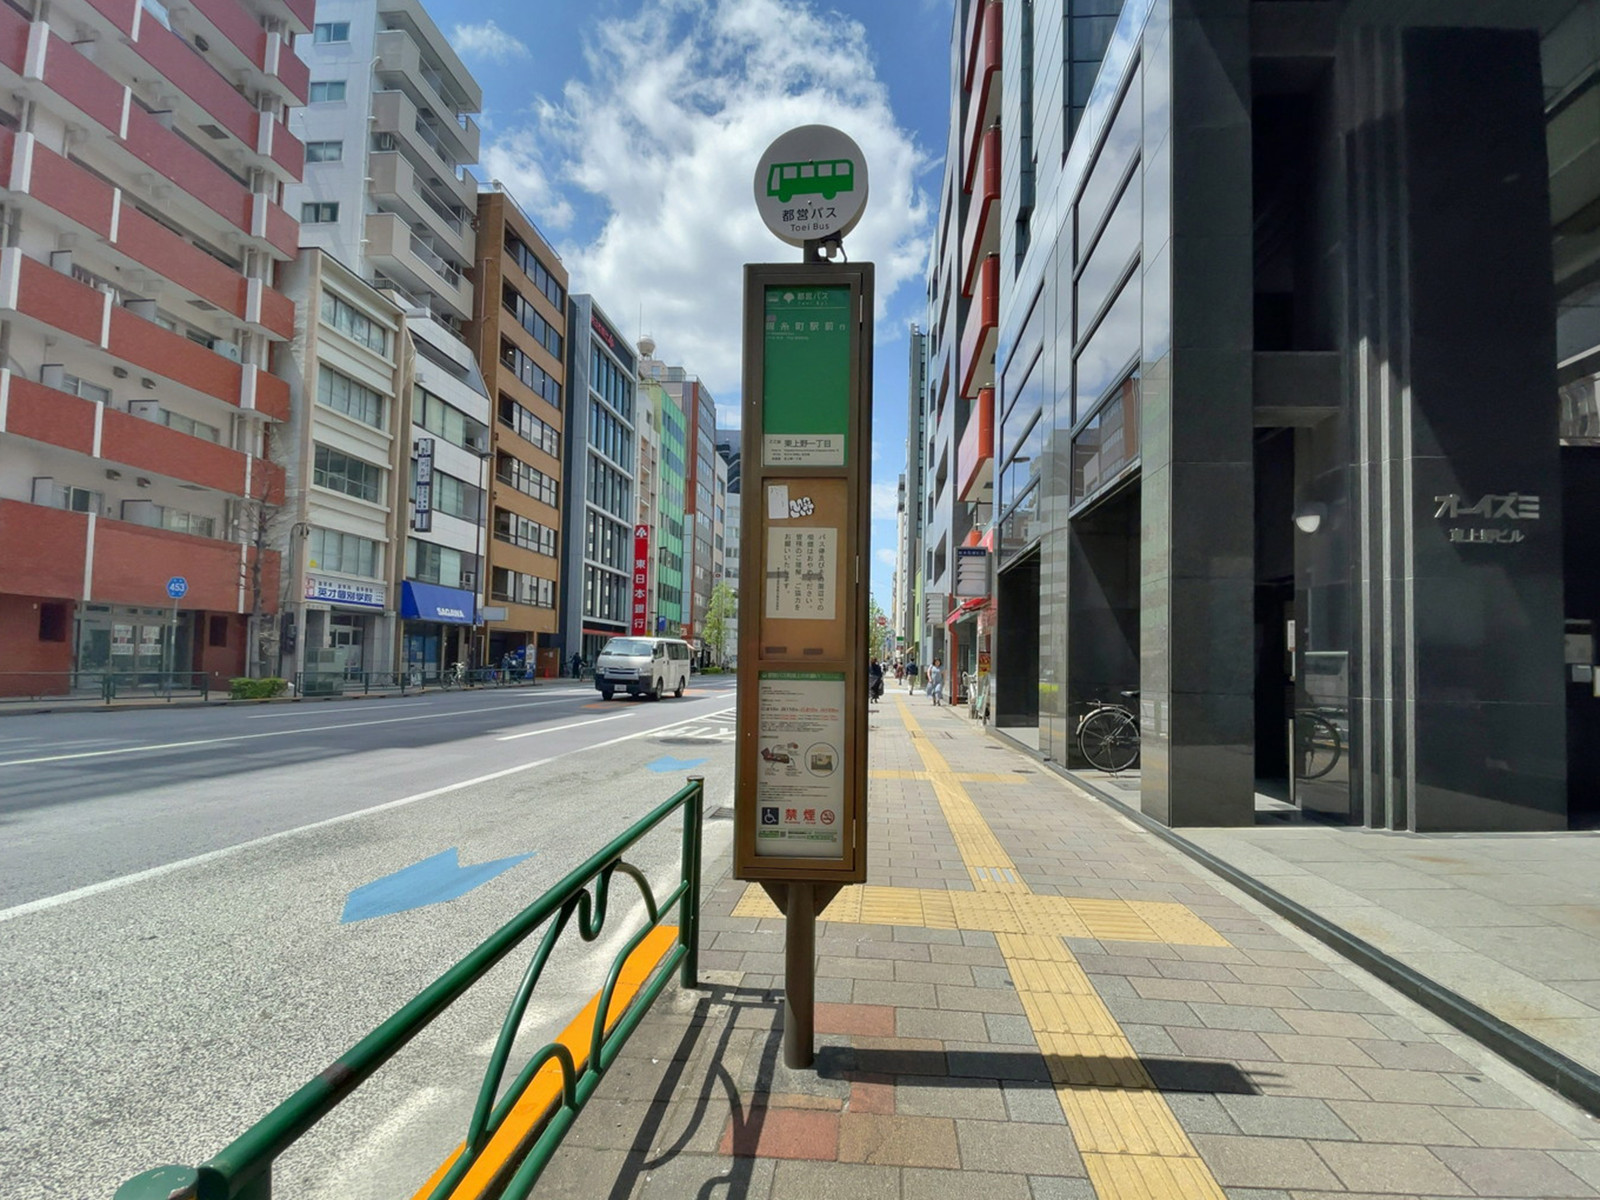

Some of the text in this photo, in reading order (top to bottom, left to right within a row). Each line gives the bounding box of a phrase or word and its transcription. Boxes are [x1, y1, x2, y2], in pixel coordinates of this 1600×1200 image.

[782, 207, 837, 222] 都営バス
[791, 222, 830, 232] Toei Bus
[784, 439, 831, 448] 東上野一丁目
[169, 583, 185, 592] 453
